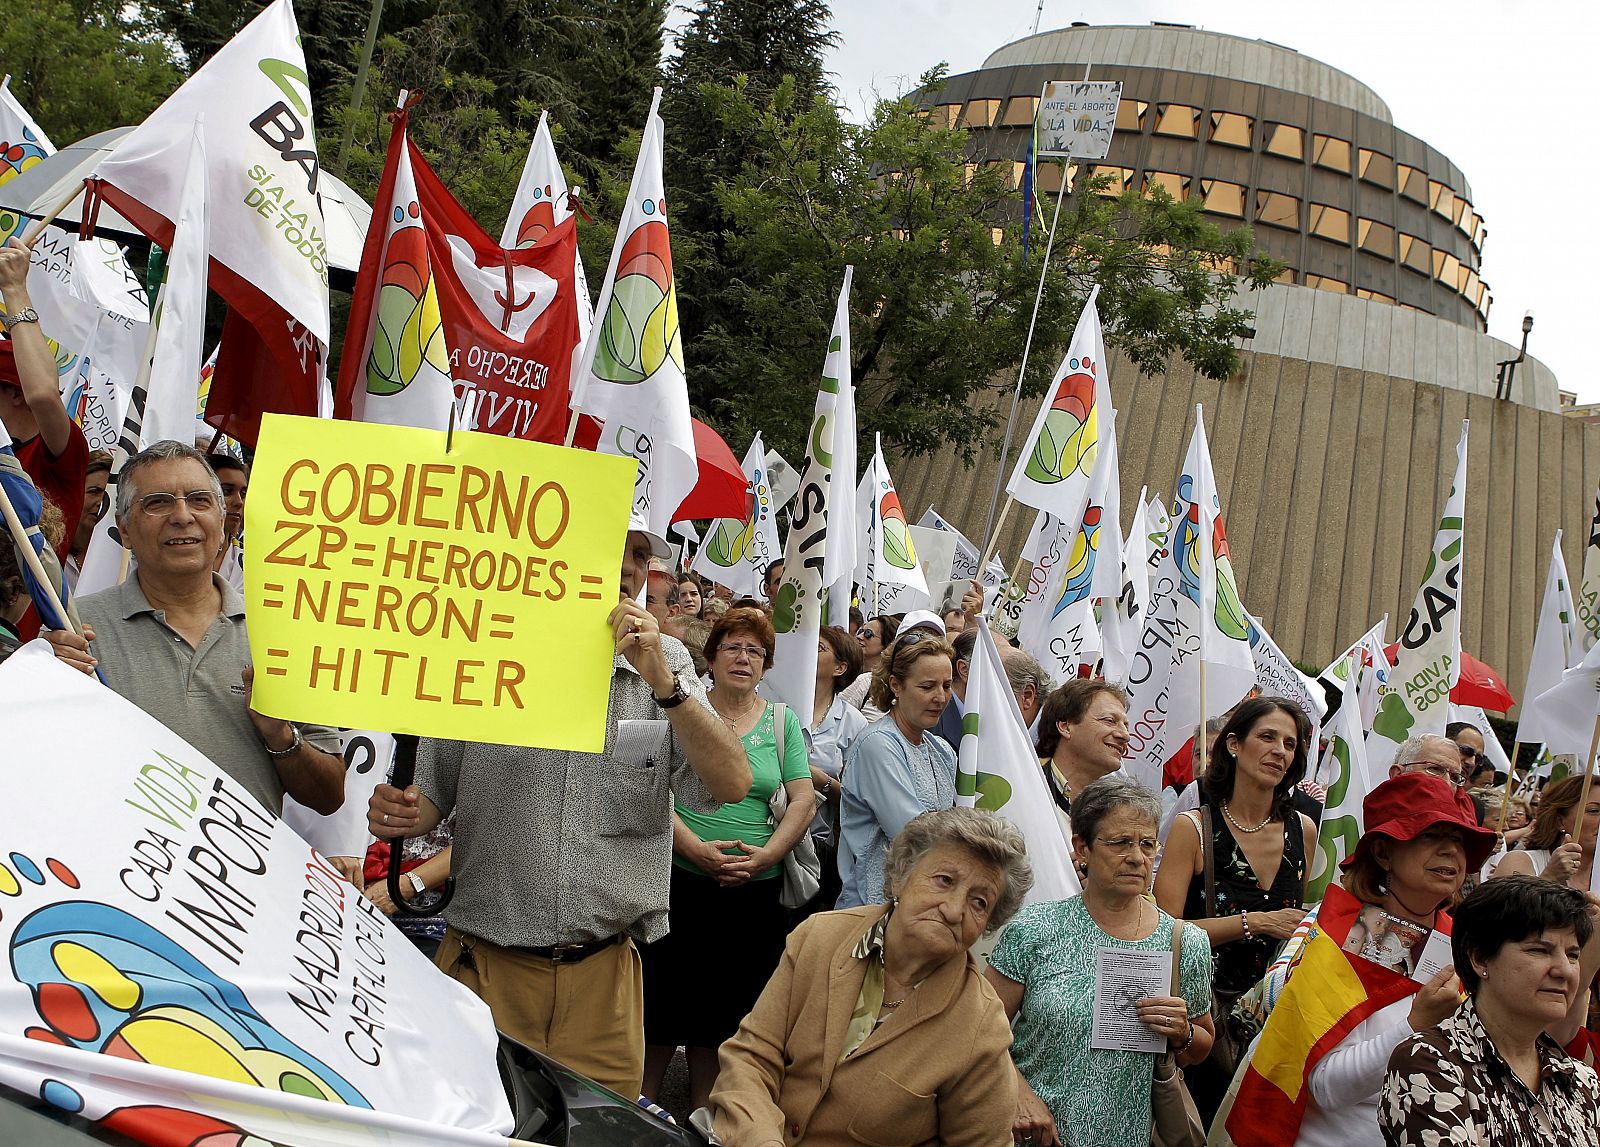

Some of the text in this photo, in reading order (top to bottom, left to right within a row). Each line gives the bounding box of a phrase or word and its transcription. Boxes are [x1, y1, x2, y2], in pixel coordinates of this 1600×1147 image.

[1044, 102, 1115, 112] ANTE EL ABORTO
[1072, 119, 1101, 132] VIDA
[243, 187, 279, 219] DE
[247, 164, 276, 186] SÍ
[266, 186, 284, 203] A
[282, 199, 308, 230] LA
[280, 458, 570, 550] GOBIERNO
[308, 645, 526, 709] HITLER
[119, 748, 207, 903] CADA VIDA
[164, 777, 278, 966] IMPORT
[344, 958, 387, 1067] CAPITAL
